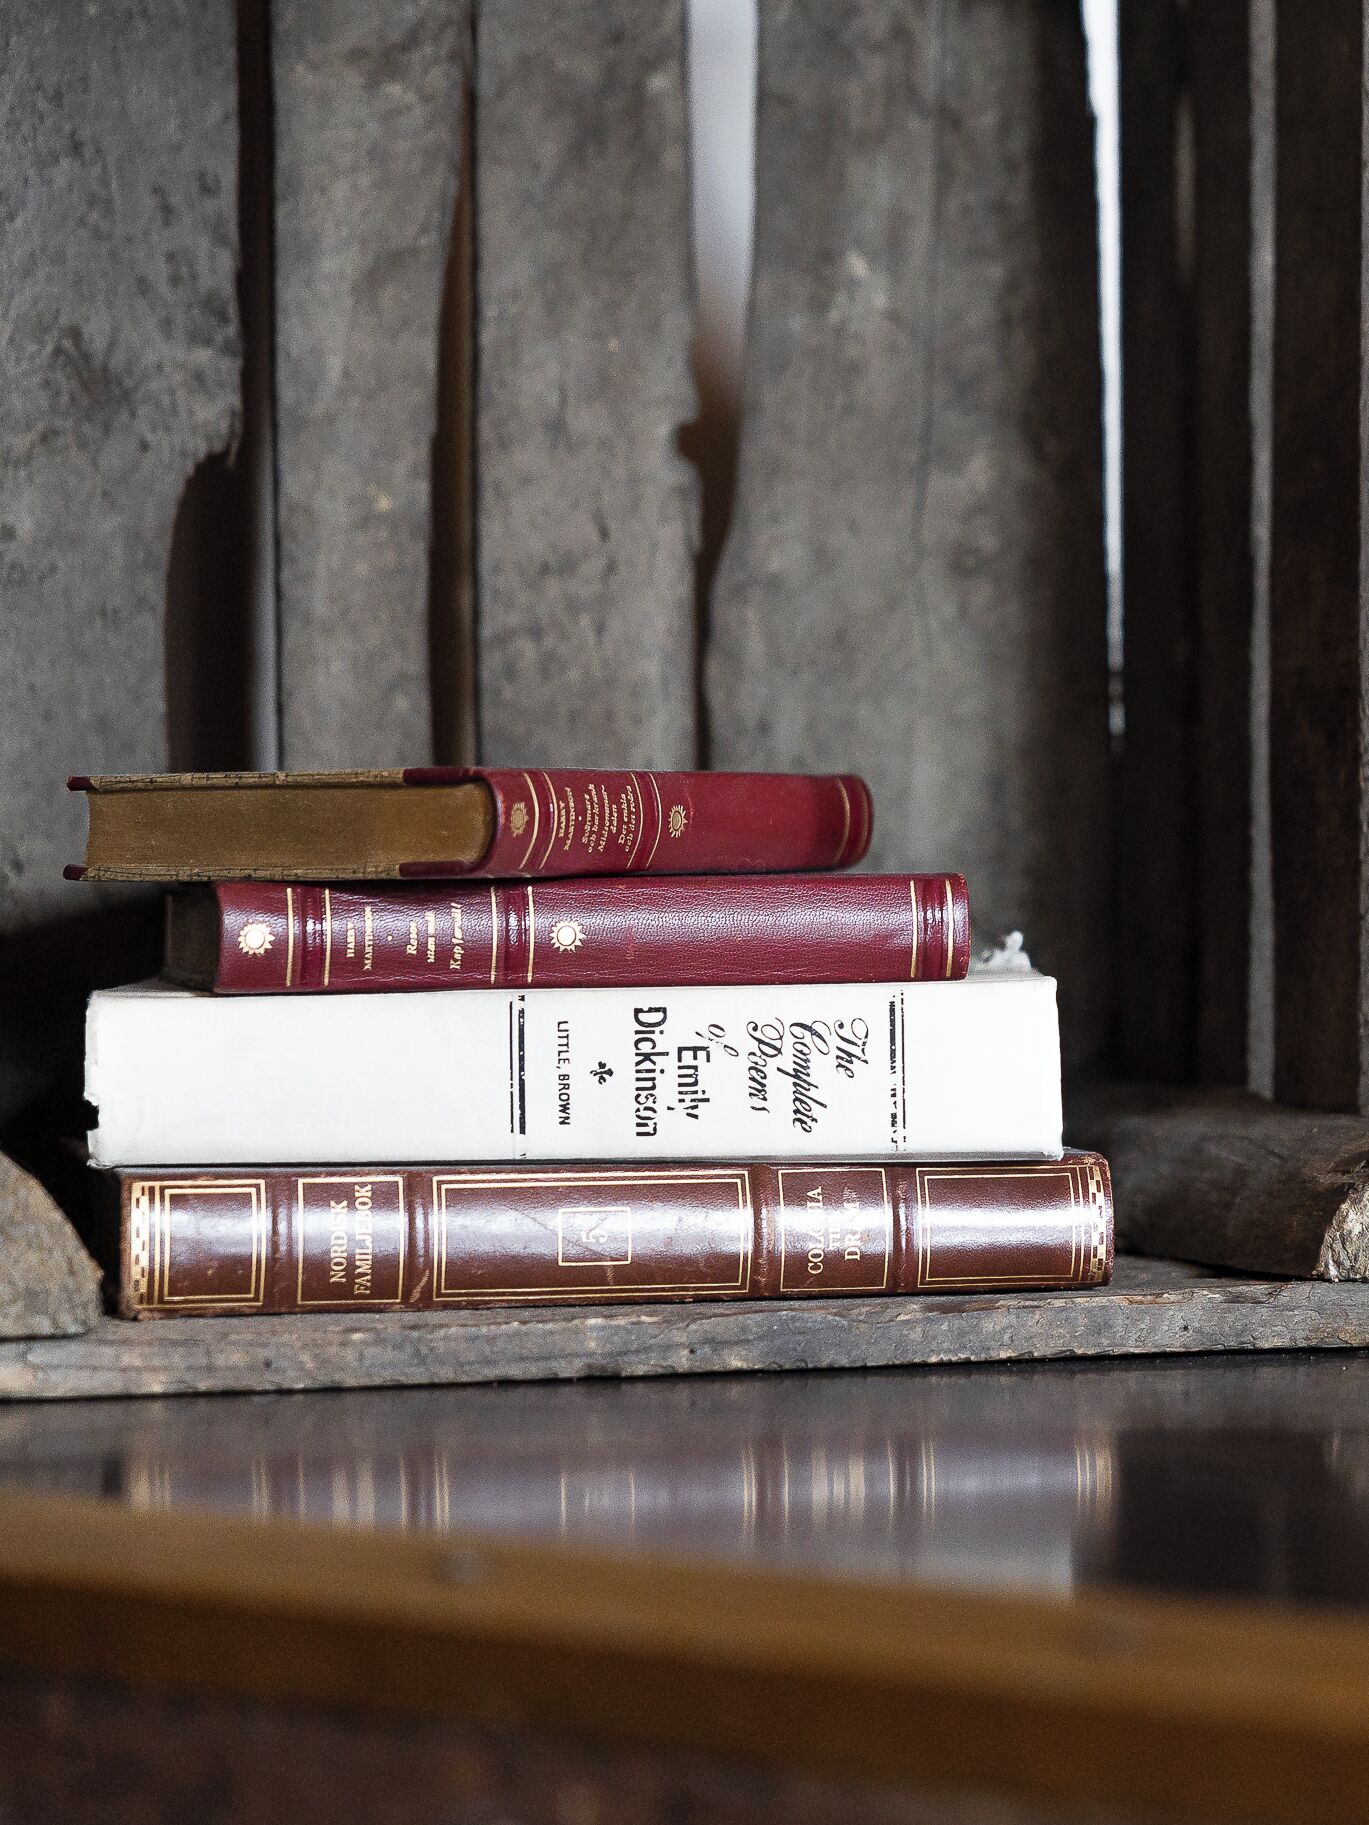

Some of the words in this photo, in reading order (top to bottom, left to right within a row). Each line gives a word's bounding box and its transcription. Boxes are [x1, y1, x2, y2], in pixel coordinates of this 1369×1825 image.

[563, 787, 575, 850] MARTINSON
[588, 833, 597, 853] och
[610, 804, 618, 833] dalen
[625, 833, 633, 852] och
[346, 918, 355, 957] HARRY
[363, 906, 373, 970] MARTINSON
[556, 1020, 570, 1069] LITTLE,
[633, 1006, 670, 1137] Dickinson
[695, 1024, 739, 1057] of
[746, 1016, 785, 1113] Poems
[833, 1017, 869, 1079] The
[558, 1073, 571, 1126] BROWN
[667, 1046, 711, 1120] Emily
[776, 1020, 832, 1133] Complete
[329, 1199, 348, 1284] NORDISK
[353, 1184, 373, 1295] FAMILJEBOK
[806, 1186, 824, 1275] COLOIA
